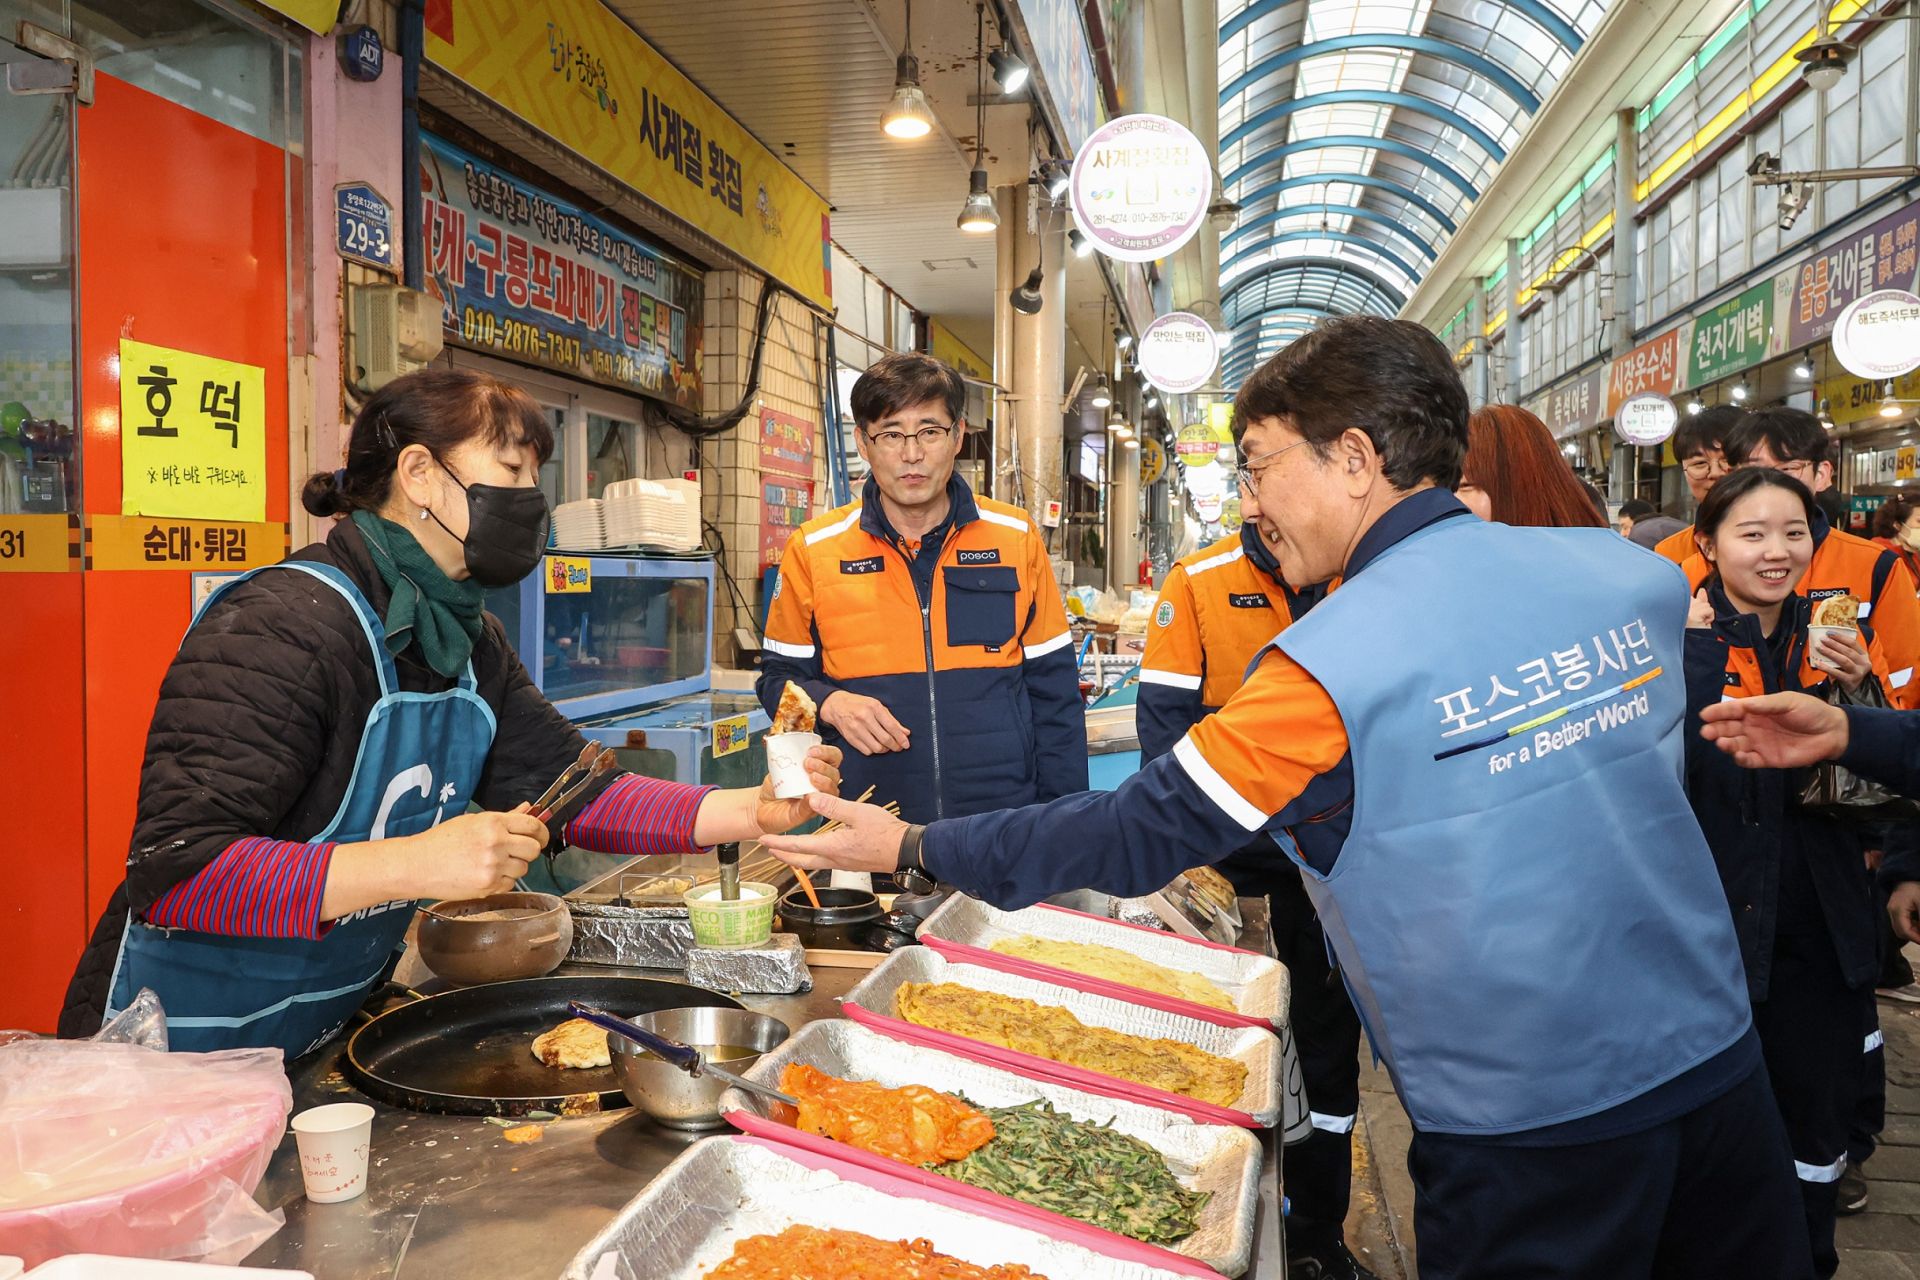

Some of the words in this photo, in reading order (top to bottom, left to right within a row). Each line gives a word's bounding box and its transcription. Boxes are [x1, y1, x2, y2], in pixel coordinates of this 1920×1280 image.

[359, 43, 380, 65] ADT
[640, 86, 704, 189] 사계절
[708, 139, 743, 217] 횟집
[1092, 144, 1189, 169] 사계절횟집
[465, 162, 529, 225] 좋은품질과
[532, 195, 599, 253] 착한가격으로
[345, 218, 386, 258] 29-3
[421, 196, 616, 340] 게·구룡포과메기
[620, 283, 686, 368] 전국택배
[1799, 233, 1876, 324] 울릉건어물
[1153, 330, 1184, 343] 맛있는
[1185, 330, 1206, 343] 떡집
[1696, 299, 1763, 370] 천지개벽
[1857, 307, 1920, 326] 해도즉석두부
[464, 306, 580, 369] 010-2876-7347
[616, 354, 664, 393] 281-4274
[1613, 338, 1672, 399] 시장옷수선
[137, 365, 241, 449] 호떡
[1554, 381, 1589, 426] 즉석어묵
[1632, 403, 1665, 413] 천지개벽
[162, 464, 181, 487] 바로
[183, 465, 200, 484] 바로
[143, 525, 246, 562] 순대·튀김
[959, 551, 997, 562] posco
[1810, 589, 1846, 599] posco
[1433, 618, 1654, 738] 포스코봉사단
[1488, 751, 1517, 775] for
[1519, 746, 1530, 764] a
[1534, 715, 1597, 758] Better
[1595, 690, 1649, 733] World
[693, 910, 720, 925] ECO
